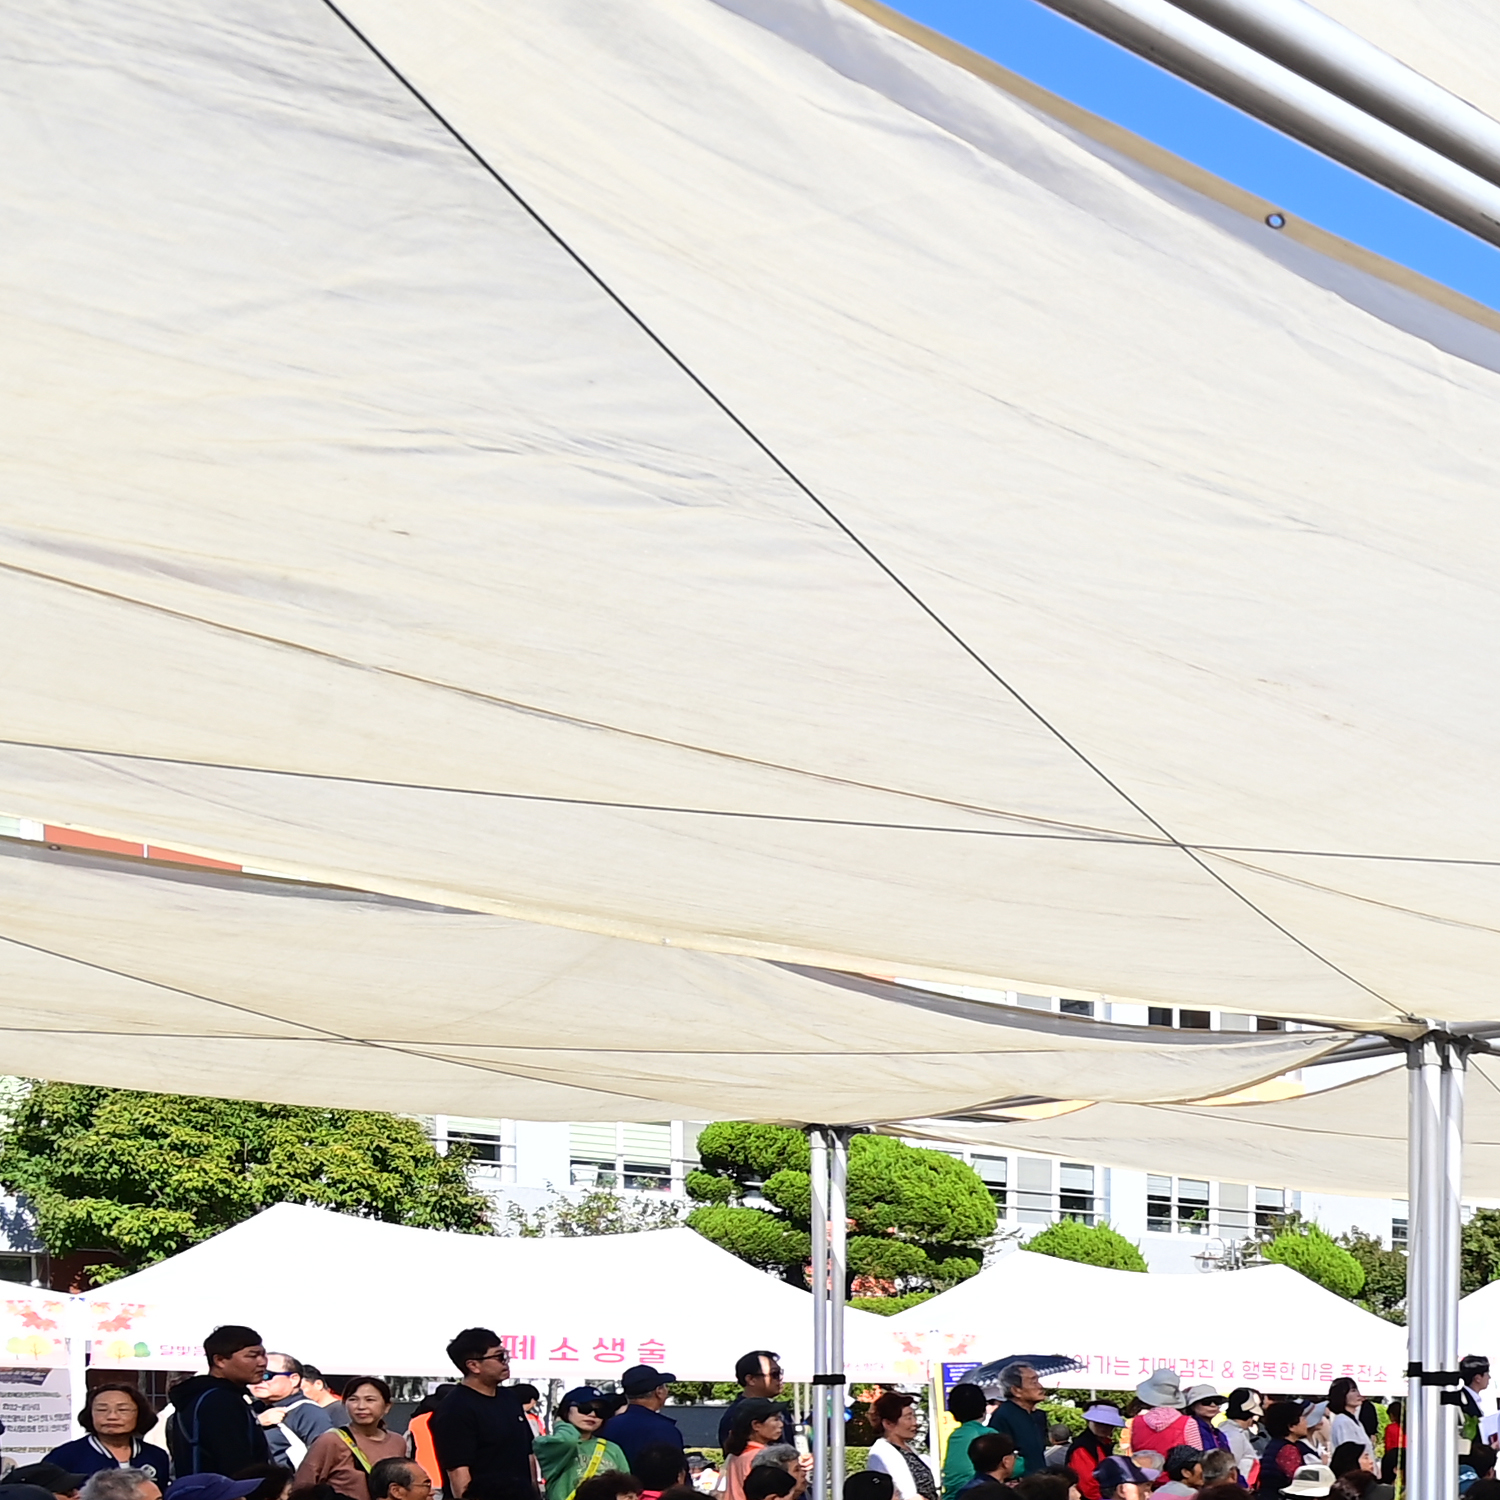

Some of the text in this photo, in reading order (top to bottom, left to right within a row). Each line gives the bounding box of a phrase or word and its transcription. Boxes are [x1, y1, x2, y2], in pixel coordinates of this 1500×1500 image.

[1221, 1360, 1235, 1379] &
[1241, 1360, 1294, 1381] 행복한
[1301, 1362, 1333, 1382] 마음
